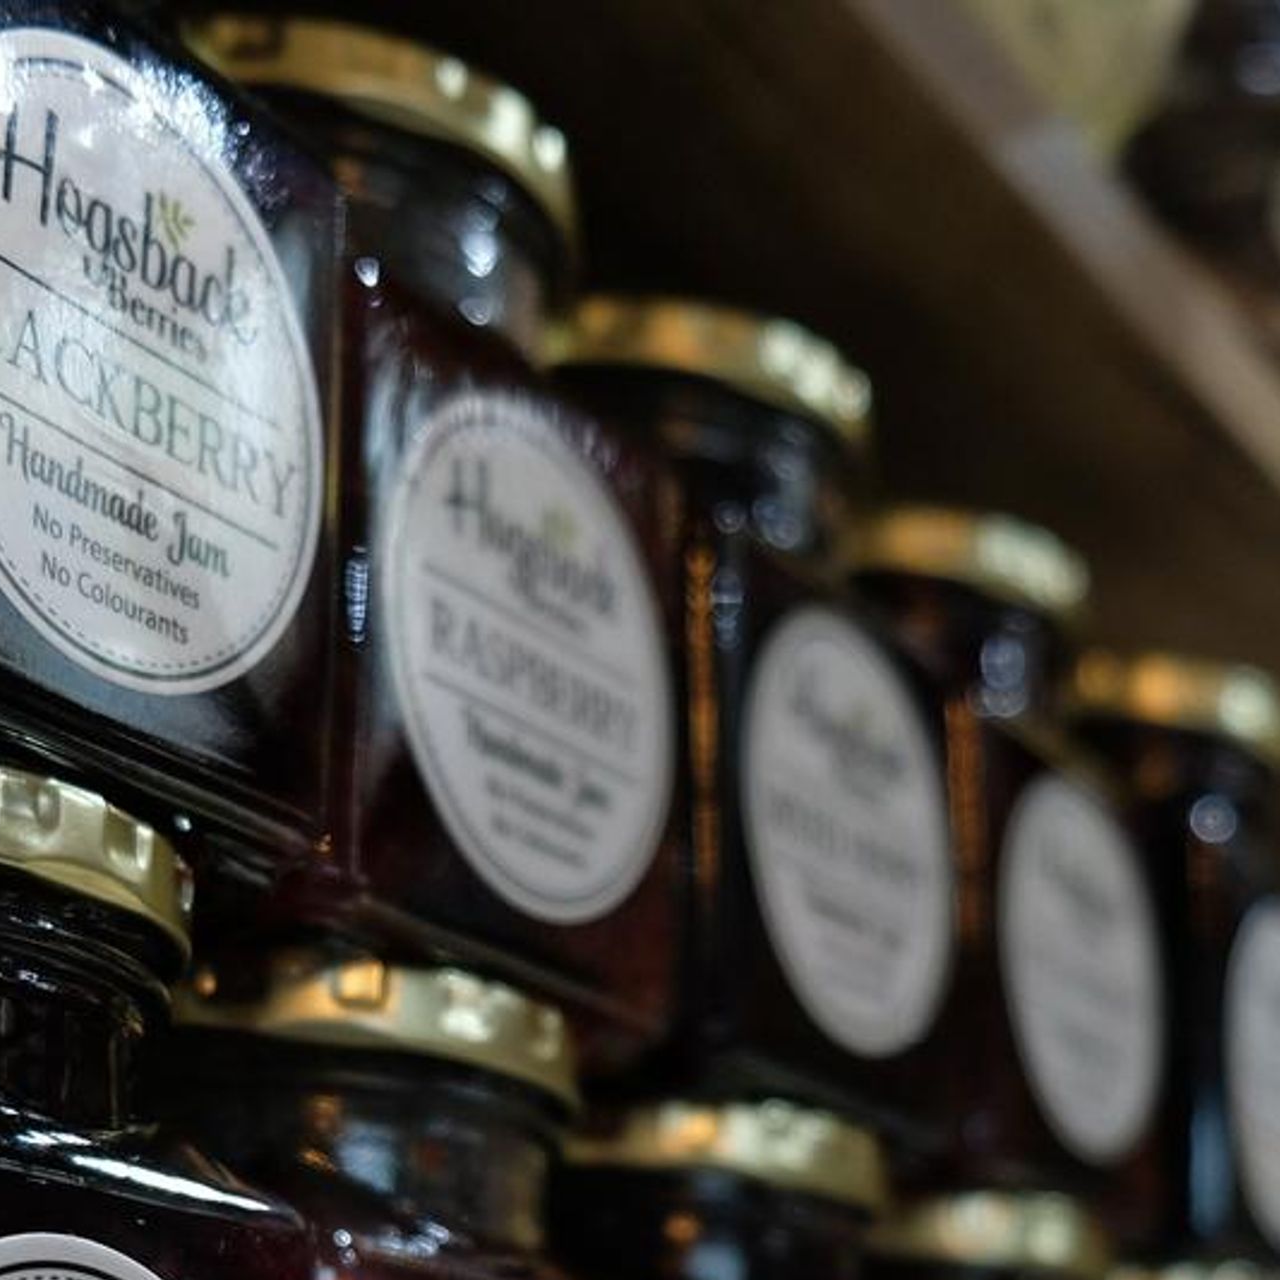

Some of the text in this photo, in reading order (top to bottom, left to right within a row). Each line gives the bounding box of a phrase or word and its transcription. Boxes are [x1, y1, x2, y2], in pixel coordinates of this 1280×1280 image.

[104, 274, 210, 365] Berries
[32, 503, 201, 611] No Preservatives
[168, 510, 231, 579] Jam
[41, 551, 190, 647] No Colourants
